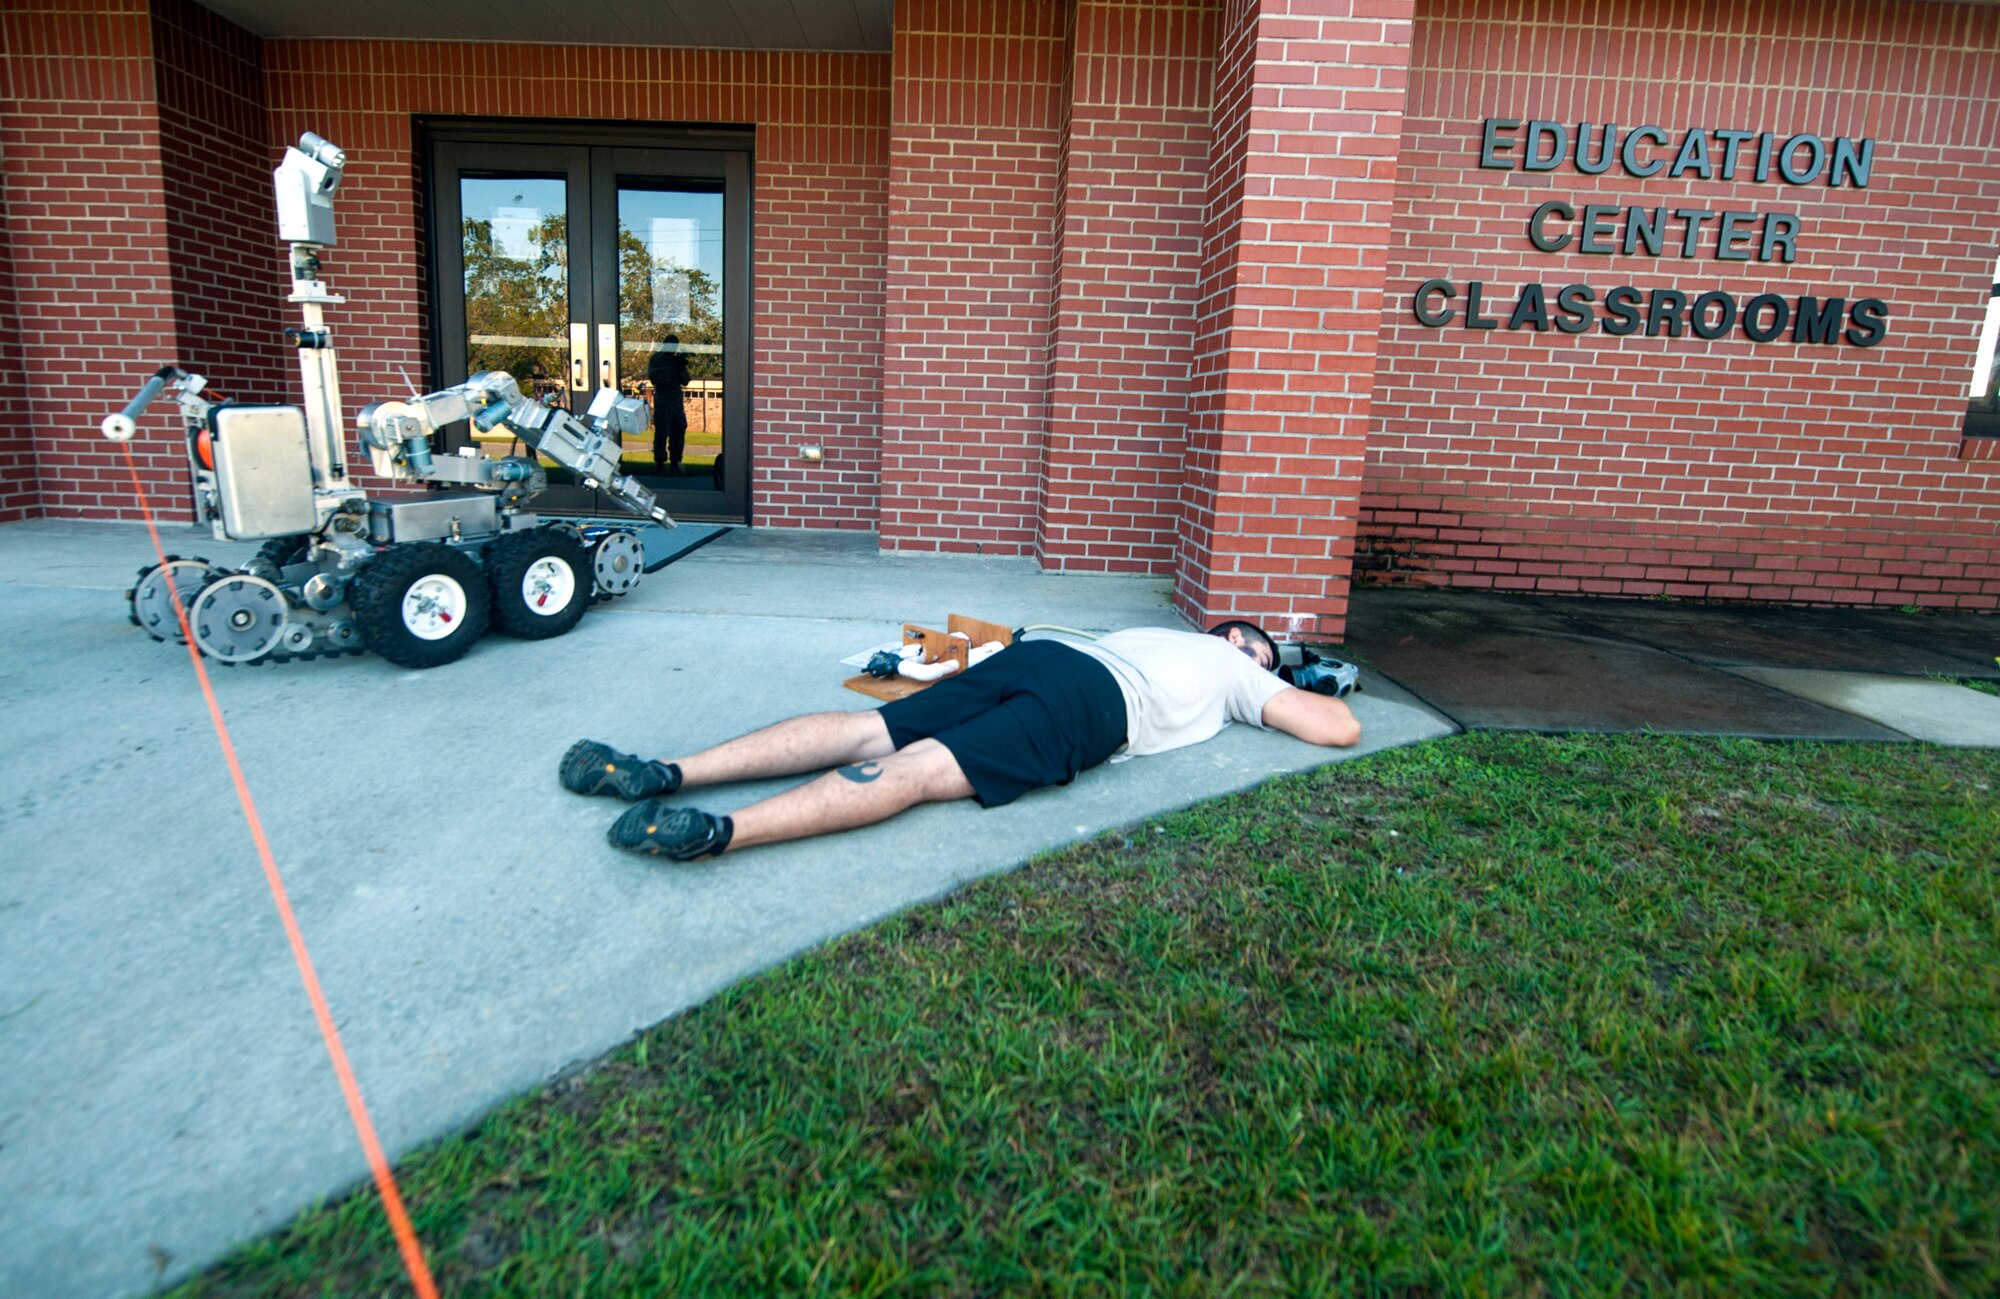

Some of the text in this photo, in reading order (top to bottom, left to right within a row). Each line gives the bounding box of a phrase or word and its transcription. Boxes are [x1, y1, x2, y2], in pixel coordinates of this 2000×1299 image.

[1480, 118, 1874, 188] EDUCATION
[1530, 200, 1801, 263] CENTER
[1414, 278, 1888, 347] CLASSROOMS
